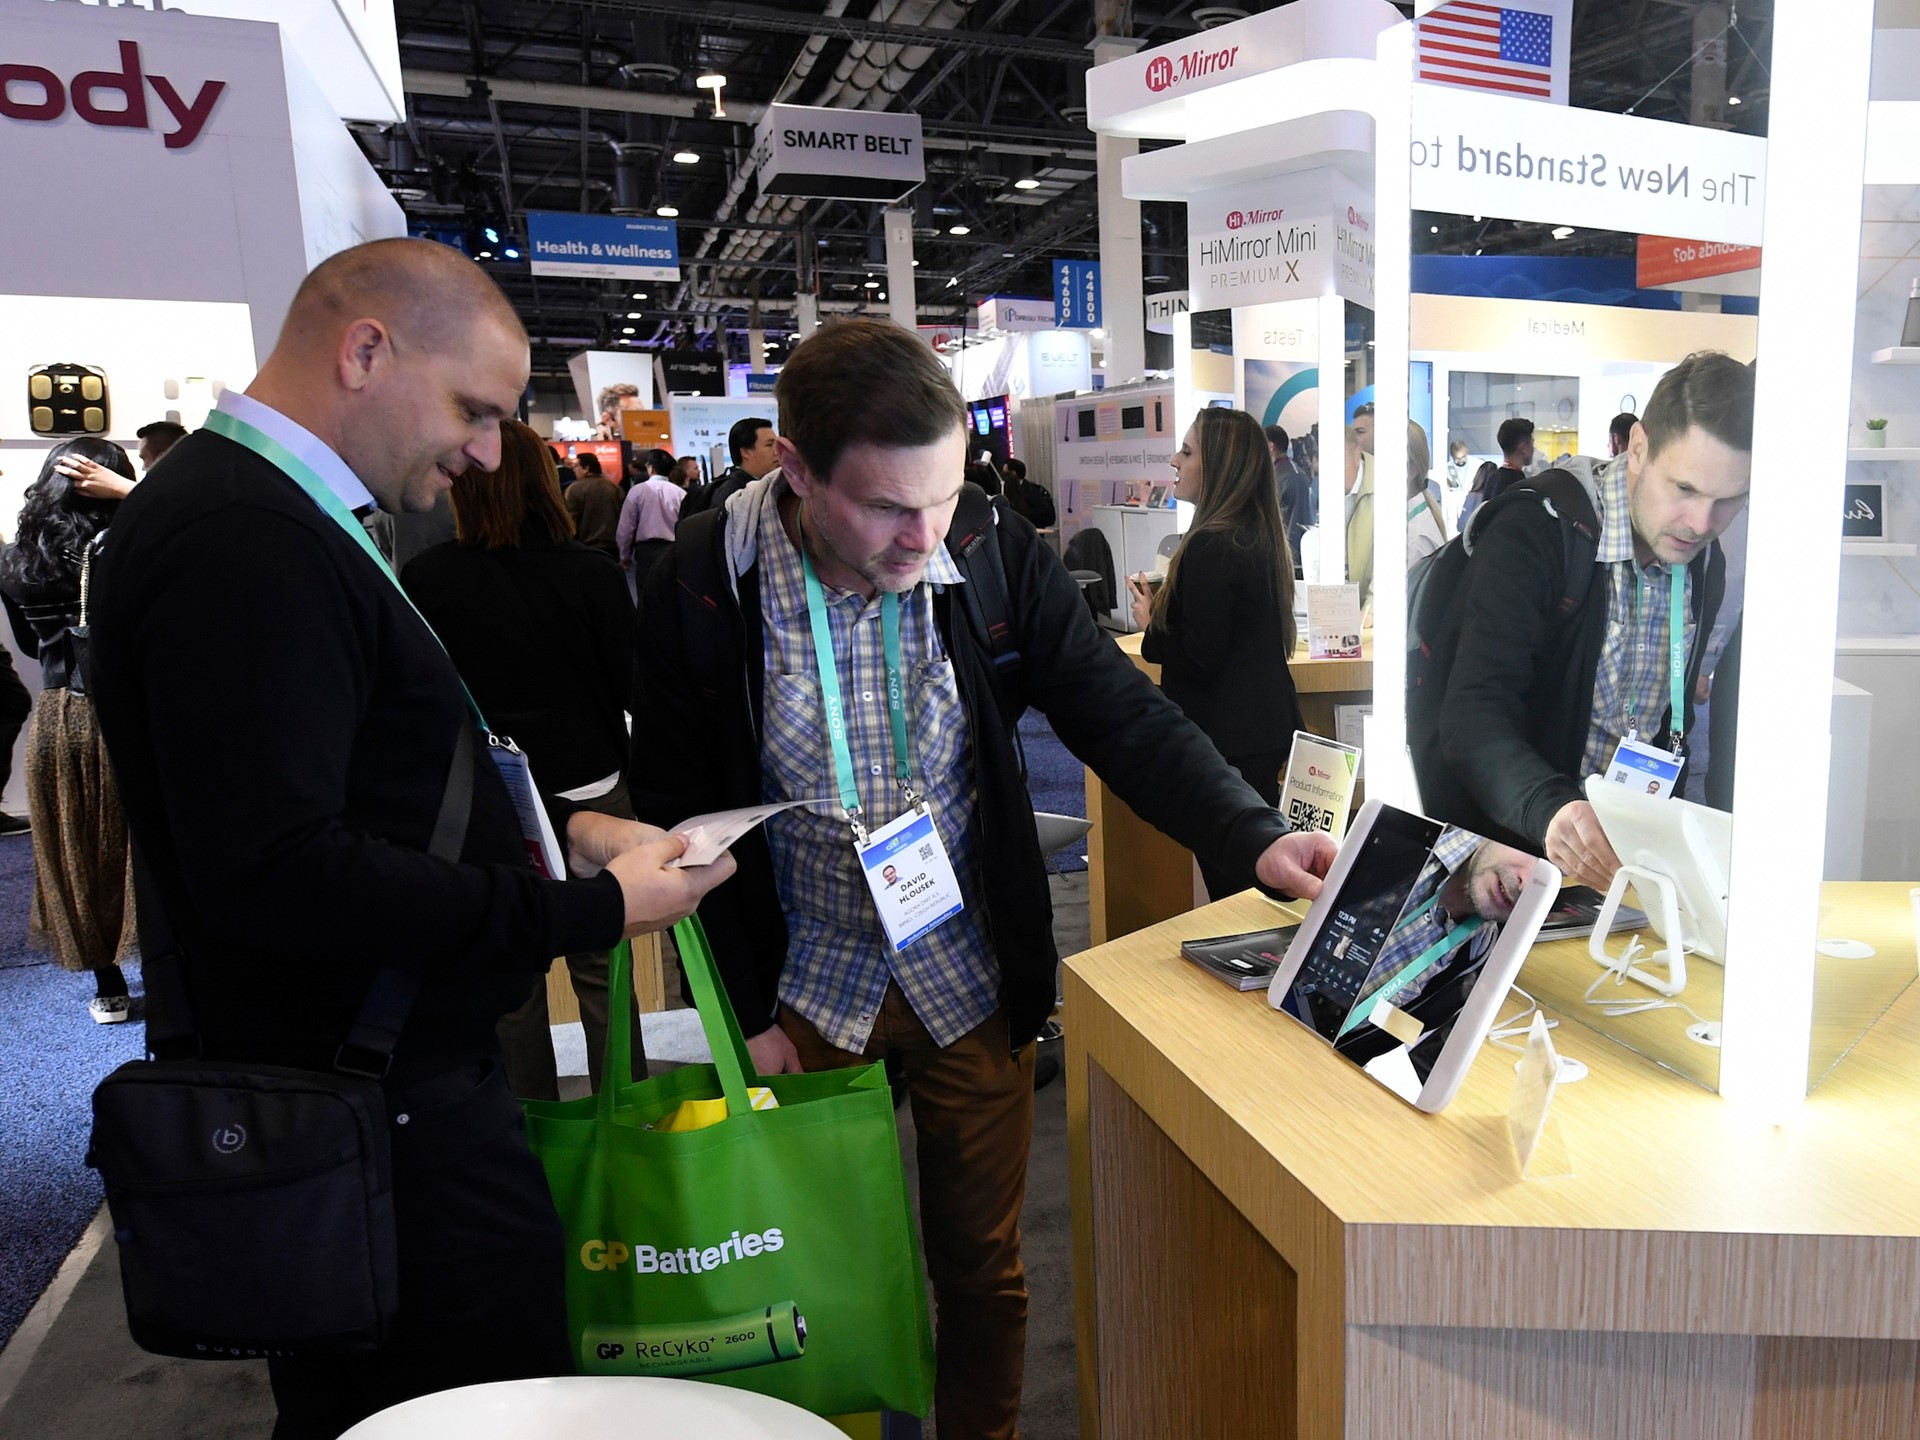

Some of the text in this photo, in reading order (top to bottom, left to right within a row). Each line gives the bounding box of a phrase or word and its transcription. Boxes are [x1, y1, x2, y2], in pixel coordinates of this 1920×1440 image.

[0, 40, 226, 148] ody
[783, 129, 912, 155] SMART BELT
[625, 224, 669, 232] MARKETPLACE
[536, 240, 673, 260] Health & Wellness
[1200, 224, 1316, 266] HiMirror Mini
[1210, 259, 1299, 288] PREMIUM X
[1051, 353, 1079, 362] WELT
[888, 666, 900, 710] SONY
[828, 694, 843, 740] SONY
[1290, 776, 1344, 803] Product Information
[899, 878, 936, 904] HLOUSEK
[900, 872, 927, 892] DAVID
[906, 910, 954, 943] Industry Attendee
[579, 1227, 784, 1274] GP Batteries
[596, 1343, 625, 1360] GP
[725, 1331, 755, 1345] 2600
[639, 1356, 714, 1369] RECHARGEABLE
